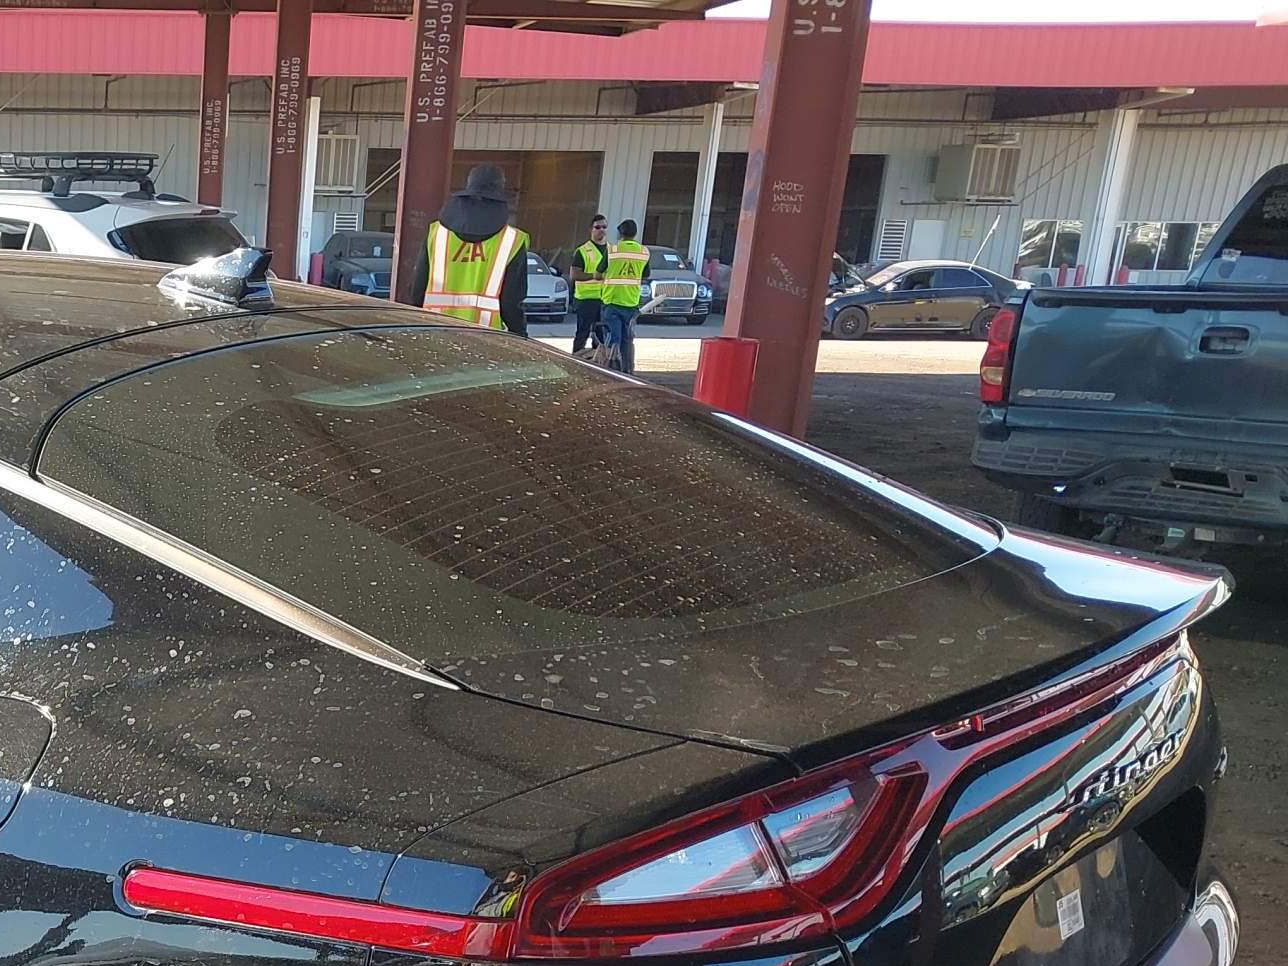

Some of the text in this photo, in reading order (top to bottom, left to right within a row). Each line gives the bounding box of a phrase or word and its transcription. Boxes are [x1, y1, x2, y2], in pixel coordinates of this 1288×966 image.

[419, 19, 438, 82] PREFAB
[277, 82, 290, 128] PREFAB
[416, 92, 432, 123] U.S.
